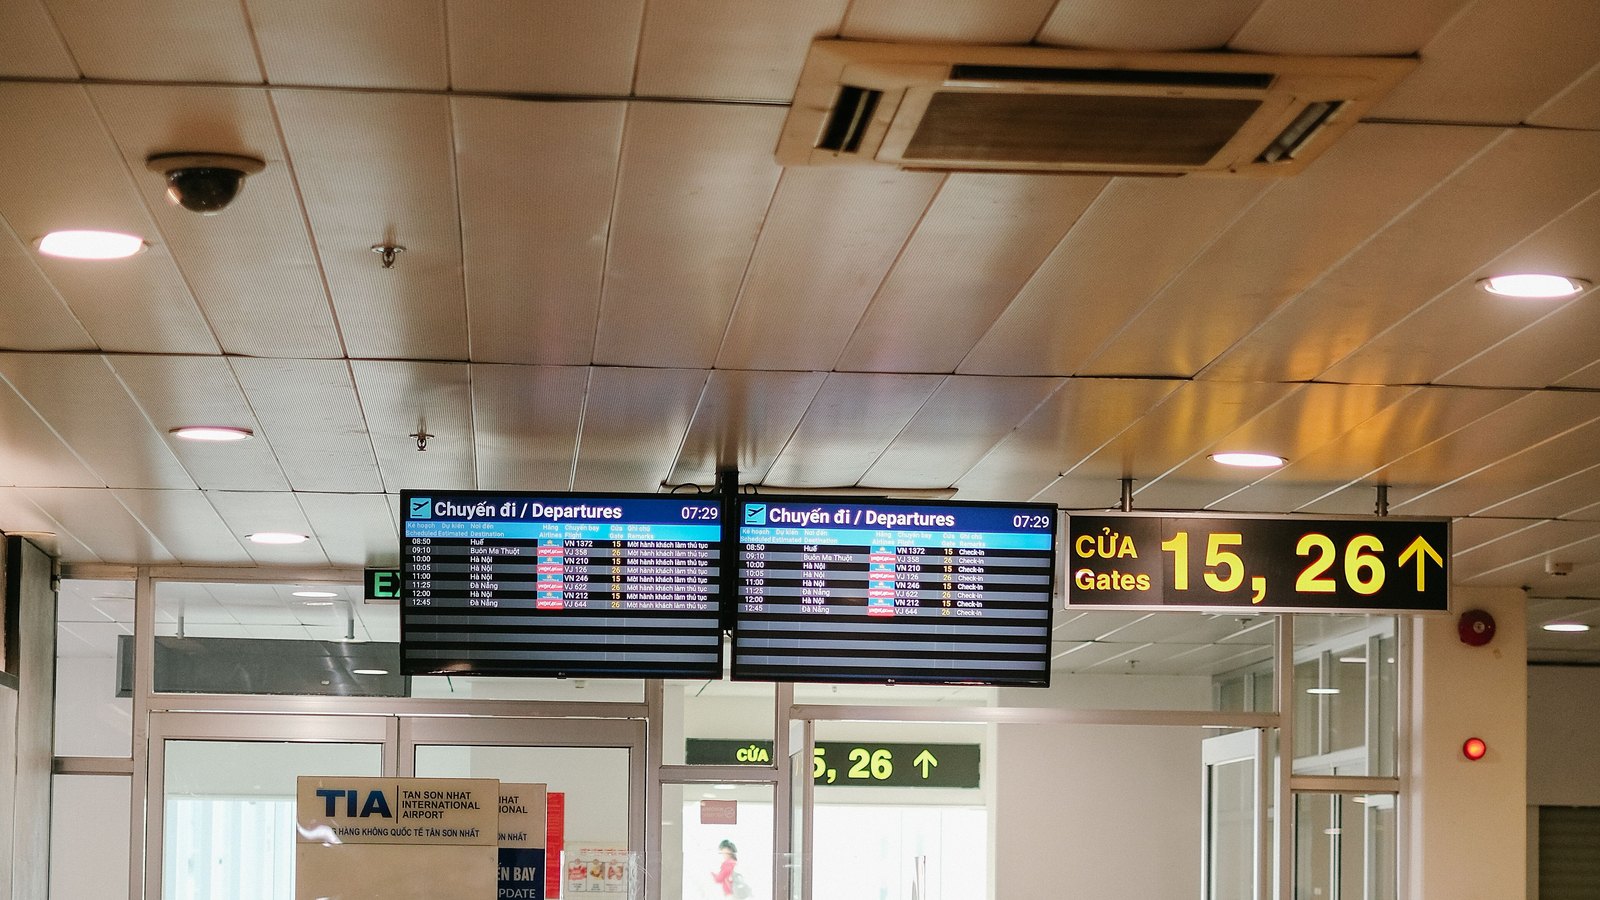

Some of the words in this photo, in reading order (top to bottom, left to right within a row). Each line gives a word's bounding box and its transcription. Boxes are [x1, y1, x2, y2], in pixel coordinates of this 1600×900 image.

[434, 501, 496, 520] Chuyến
[500, 502, 516, 517] đi
[520, 503, 528, 518] /
[532, 503, 622, 521] Departures
[681, 507, 718, 520] 07:29
[769, 508, 830, 527] Chuyến
[834, 509, 850, 524] đi
[854, 510, 862, 525] /
[866, 510, 955, 528] Departures
[1013, 516, 1050, 528] 07:29
[1075, 527, 1138, 559] CỬA
[1161, 532, 1267, 604] 15,
[1295, 534, 1386, 595] 26
[1075, 568, 1150, 591] Gates
[736, 744, 769, 763] CỬA
[814, 748, 837, 784] 5,
[848, 748, 893, 779] 26
[316, 790, 392, 818] TIA
[403, 791, 421, 799] TAN
[424, 792, 444, 800] SON
[446, 792, 471, 800] NHAT
[402, 801, 480, 810] INTERNATIONAL
[403, 811, 444, 819] AIRPORT
[514, 867, 536, 881] BAY
[499, 888, 535, 898] PDATE
